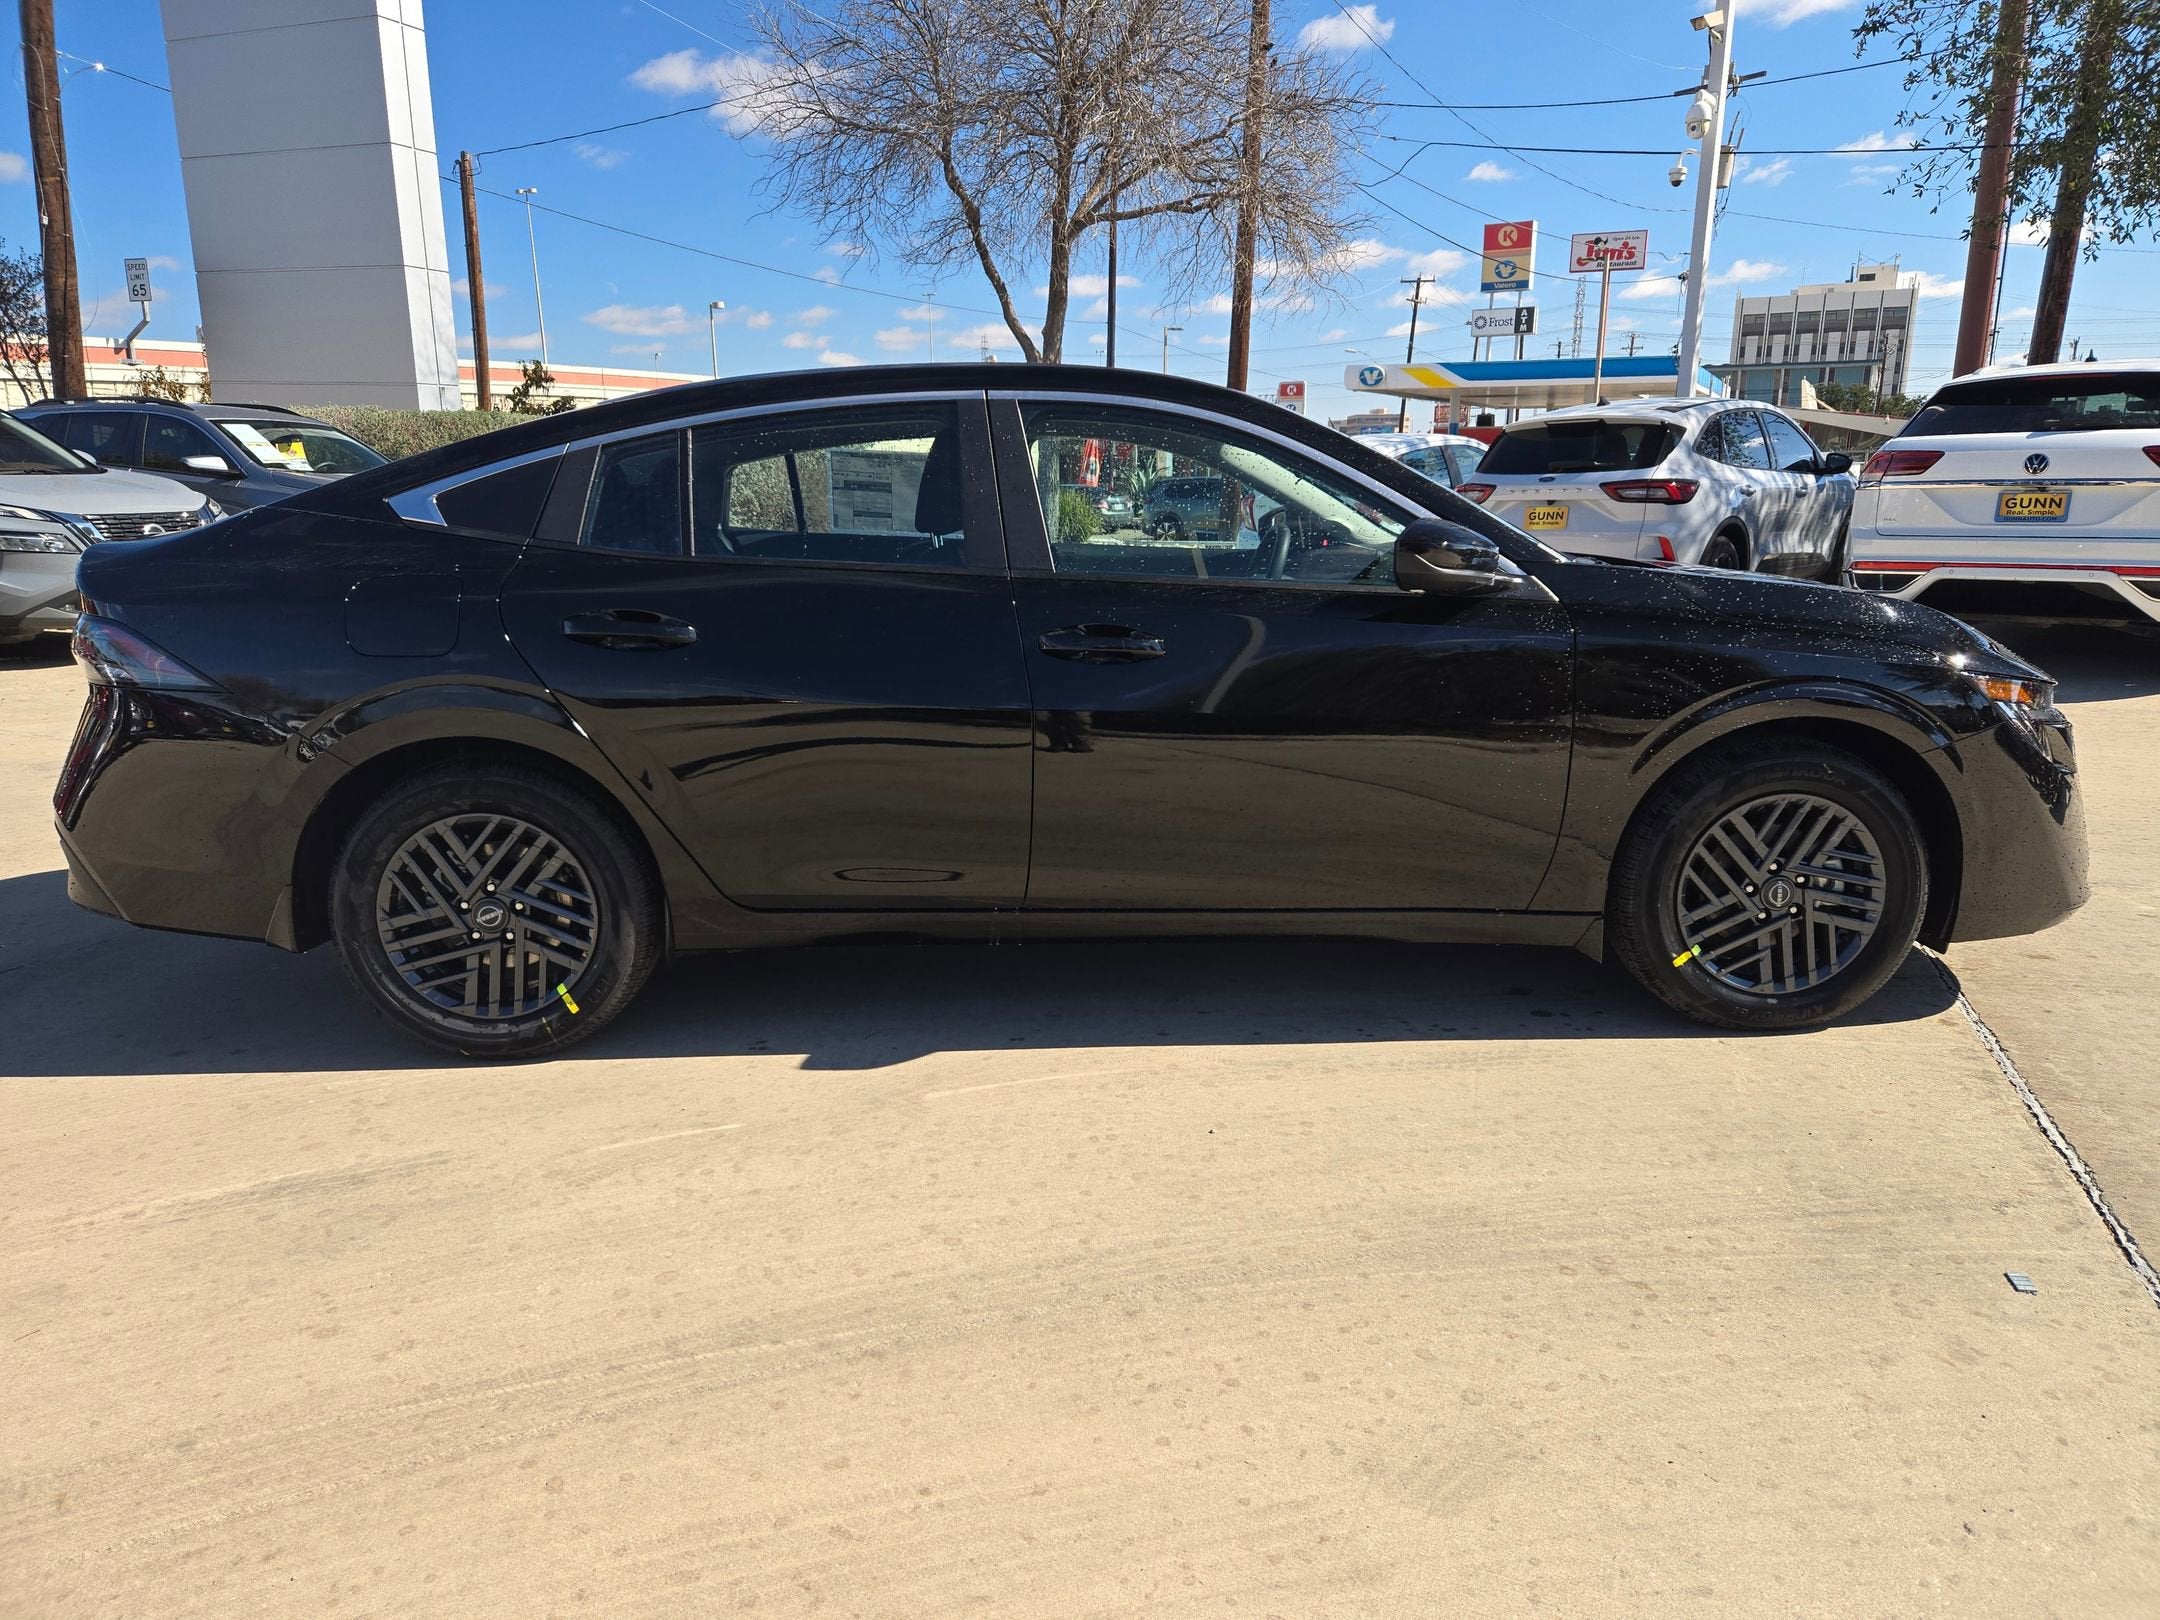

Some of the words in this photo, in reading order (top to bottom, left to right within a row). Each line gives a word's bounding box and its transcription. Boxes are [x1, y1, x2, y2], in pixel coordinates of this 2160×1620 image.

[127, 263, 146, 271] SPEED
[1596, 260, 1638, 268] Retaurant
[130, 273, 145, 281] LIMIT
[132, 283, 147, 297] 65
[1493, 282, 1517, 290] Valero
[1488, 316, 1514, 328] Frost
[1519, 308, 1528, 332] ATM
[2004, 497, 2063, 509] GUNN
[1528, 511, 1565, 521] GUNN
